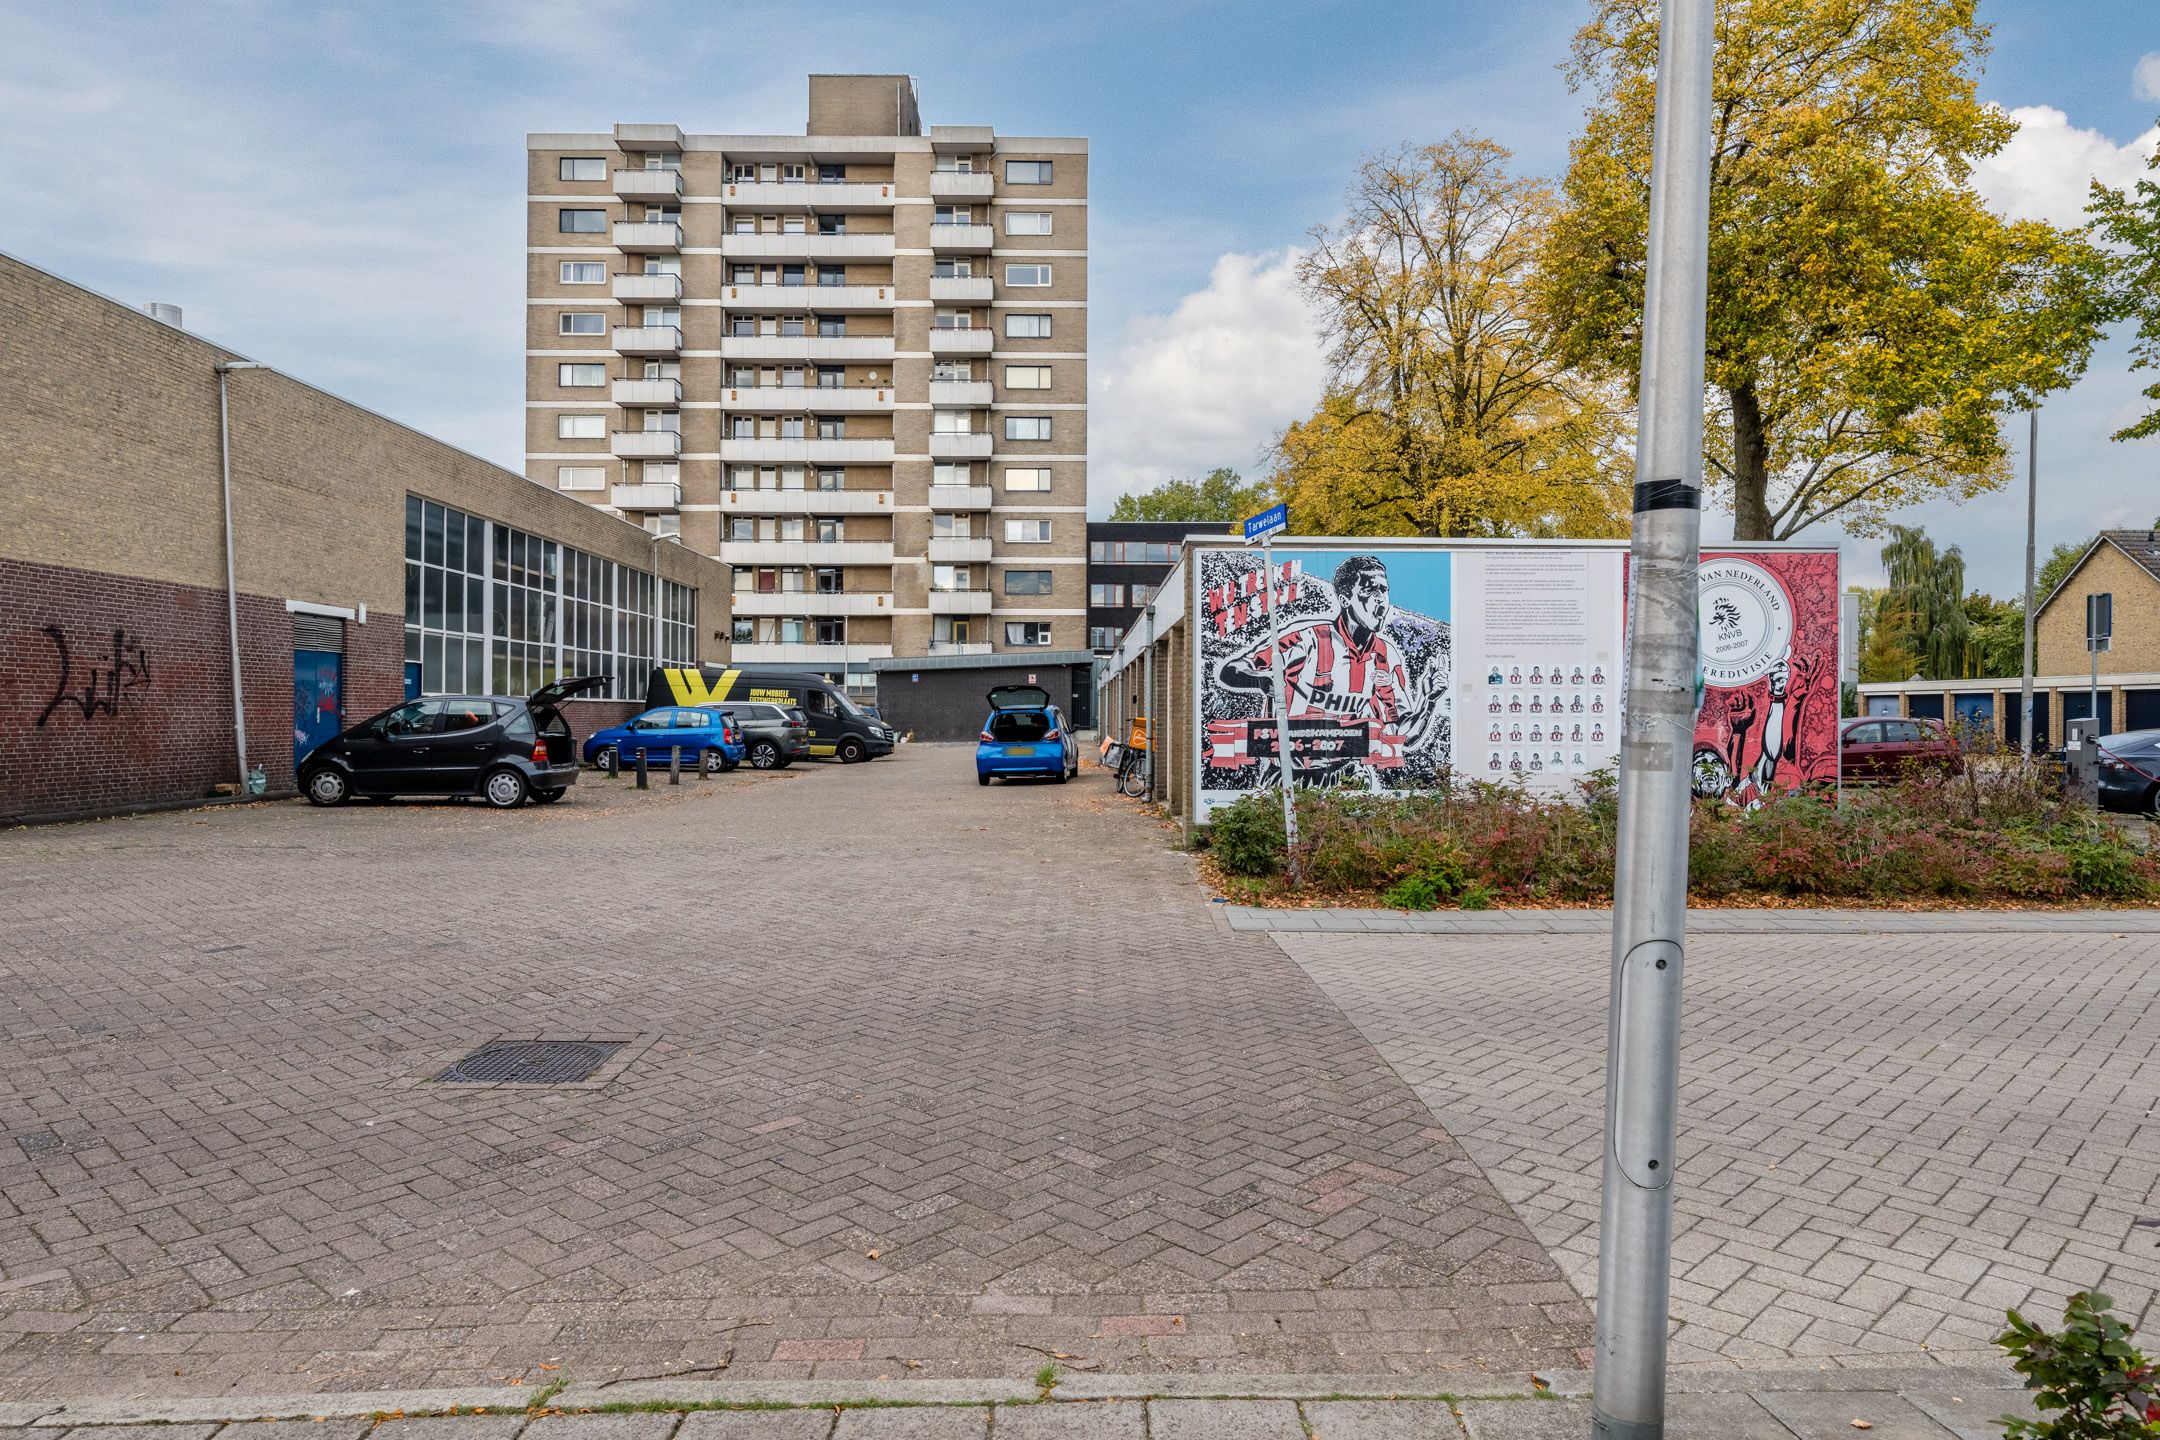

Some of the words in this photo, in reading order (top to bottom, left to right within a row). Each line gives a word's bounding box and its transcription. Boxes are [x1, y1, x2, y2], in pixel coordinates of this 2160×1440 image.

[1247, 511, 1282, 533] Tarwelaan
[1208, 580, 1235, 613] WIJ
[1700, 570, 1722, 582] VAN
[1725, 569, 1780, 611] NEDERLAND
[1214, 602, 1247, 637] TEN
[1718, 629, 1743, 641] KNVB
[1715, 640, 1748, 653] 2006-2007
[1703, 651, 1773, 678] EREDIVISIE
[750, 688, 765, 697] JOUW
[766, 689, 789, 698] MOBIELE
[1253, 728, 1279, 740] PSV
[1288, 728, 1363, 738] ANDSKAMPIOEN
[1270, 739, 1345, 752] 206-2007
